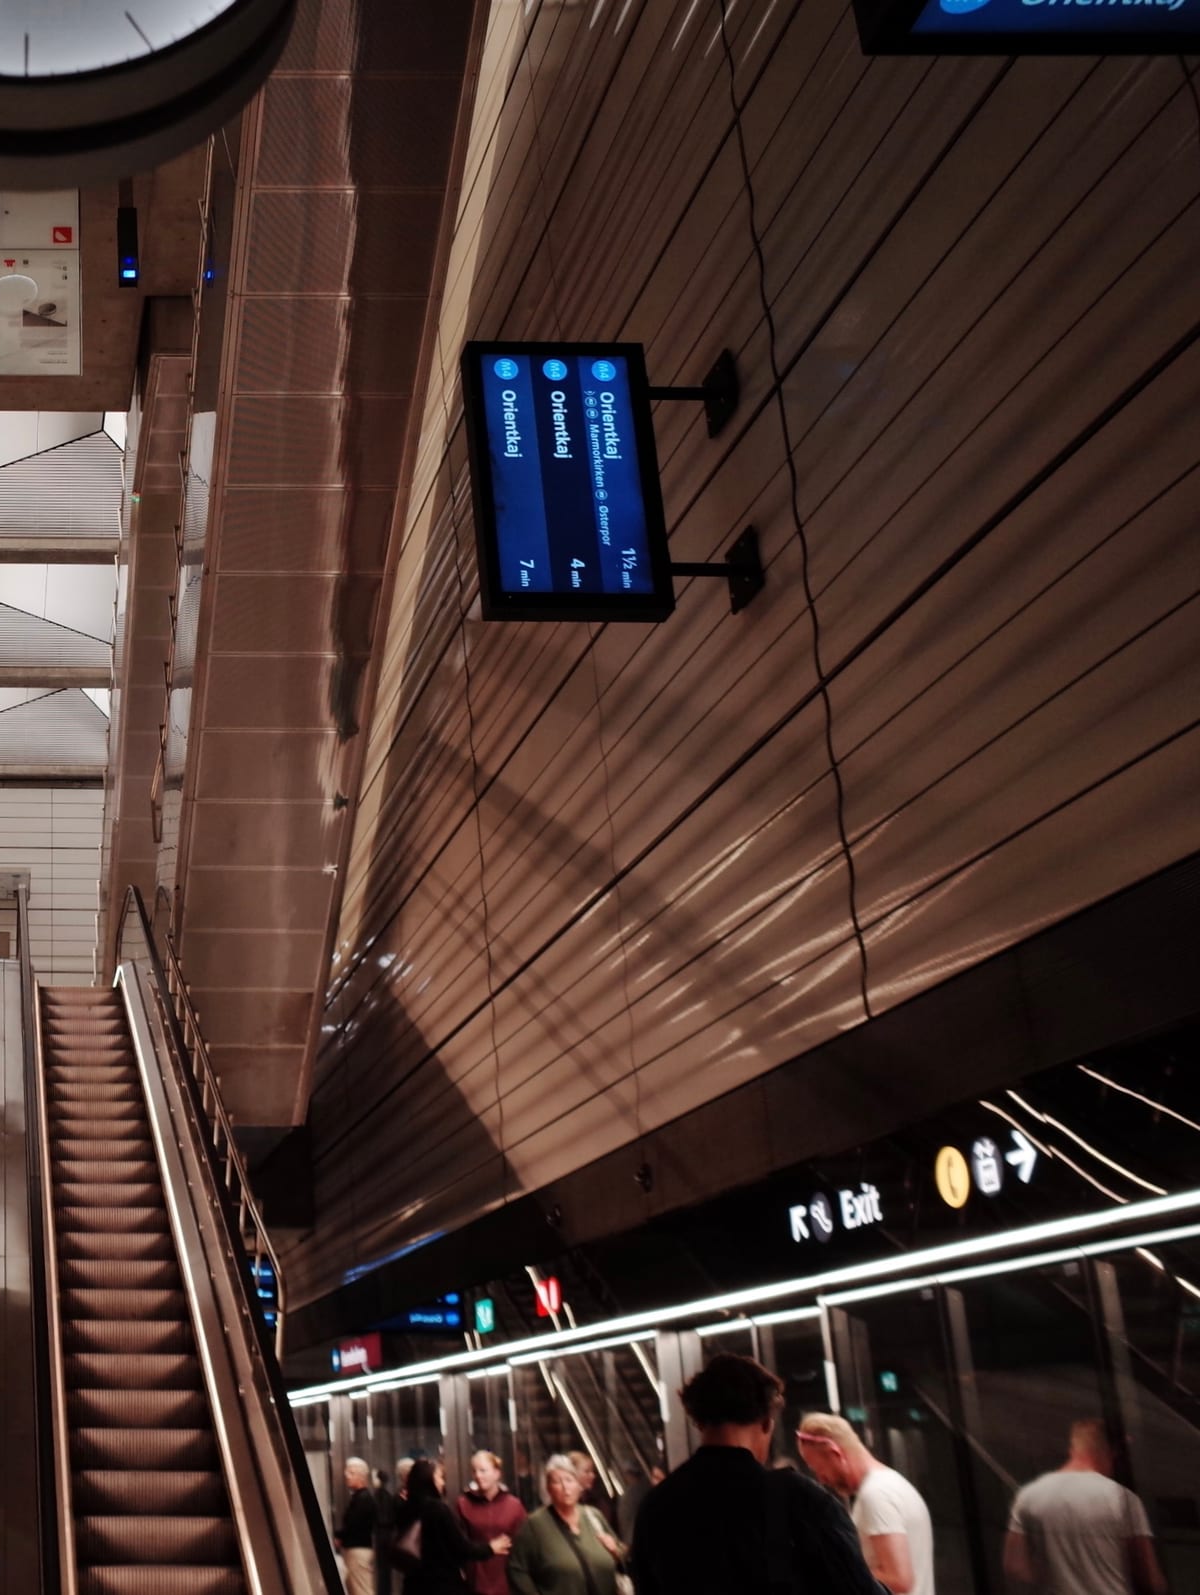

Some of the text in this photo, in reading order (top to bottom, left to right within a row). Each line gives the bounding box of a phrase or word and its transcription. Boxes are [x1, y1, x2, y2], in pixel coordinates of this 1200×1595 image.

[502, 389, 523, 458] Orientkaj
[551, 390, 573, 459] Orientkaj
[600, 391, 622, 460] Orientkaj
[588, 424, 605, 487] Marmorkirken
[520, 559, 535, 569] 7
[571, 558, 585, 568] 4
[621, 547, 638, 570] 1½
[520, 570, 529, 587] min
[571, 570, 580, 588] min
[621, 571, 633, 589] min
[839, 1182, 883, 1229] Exit
